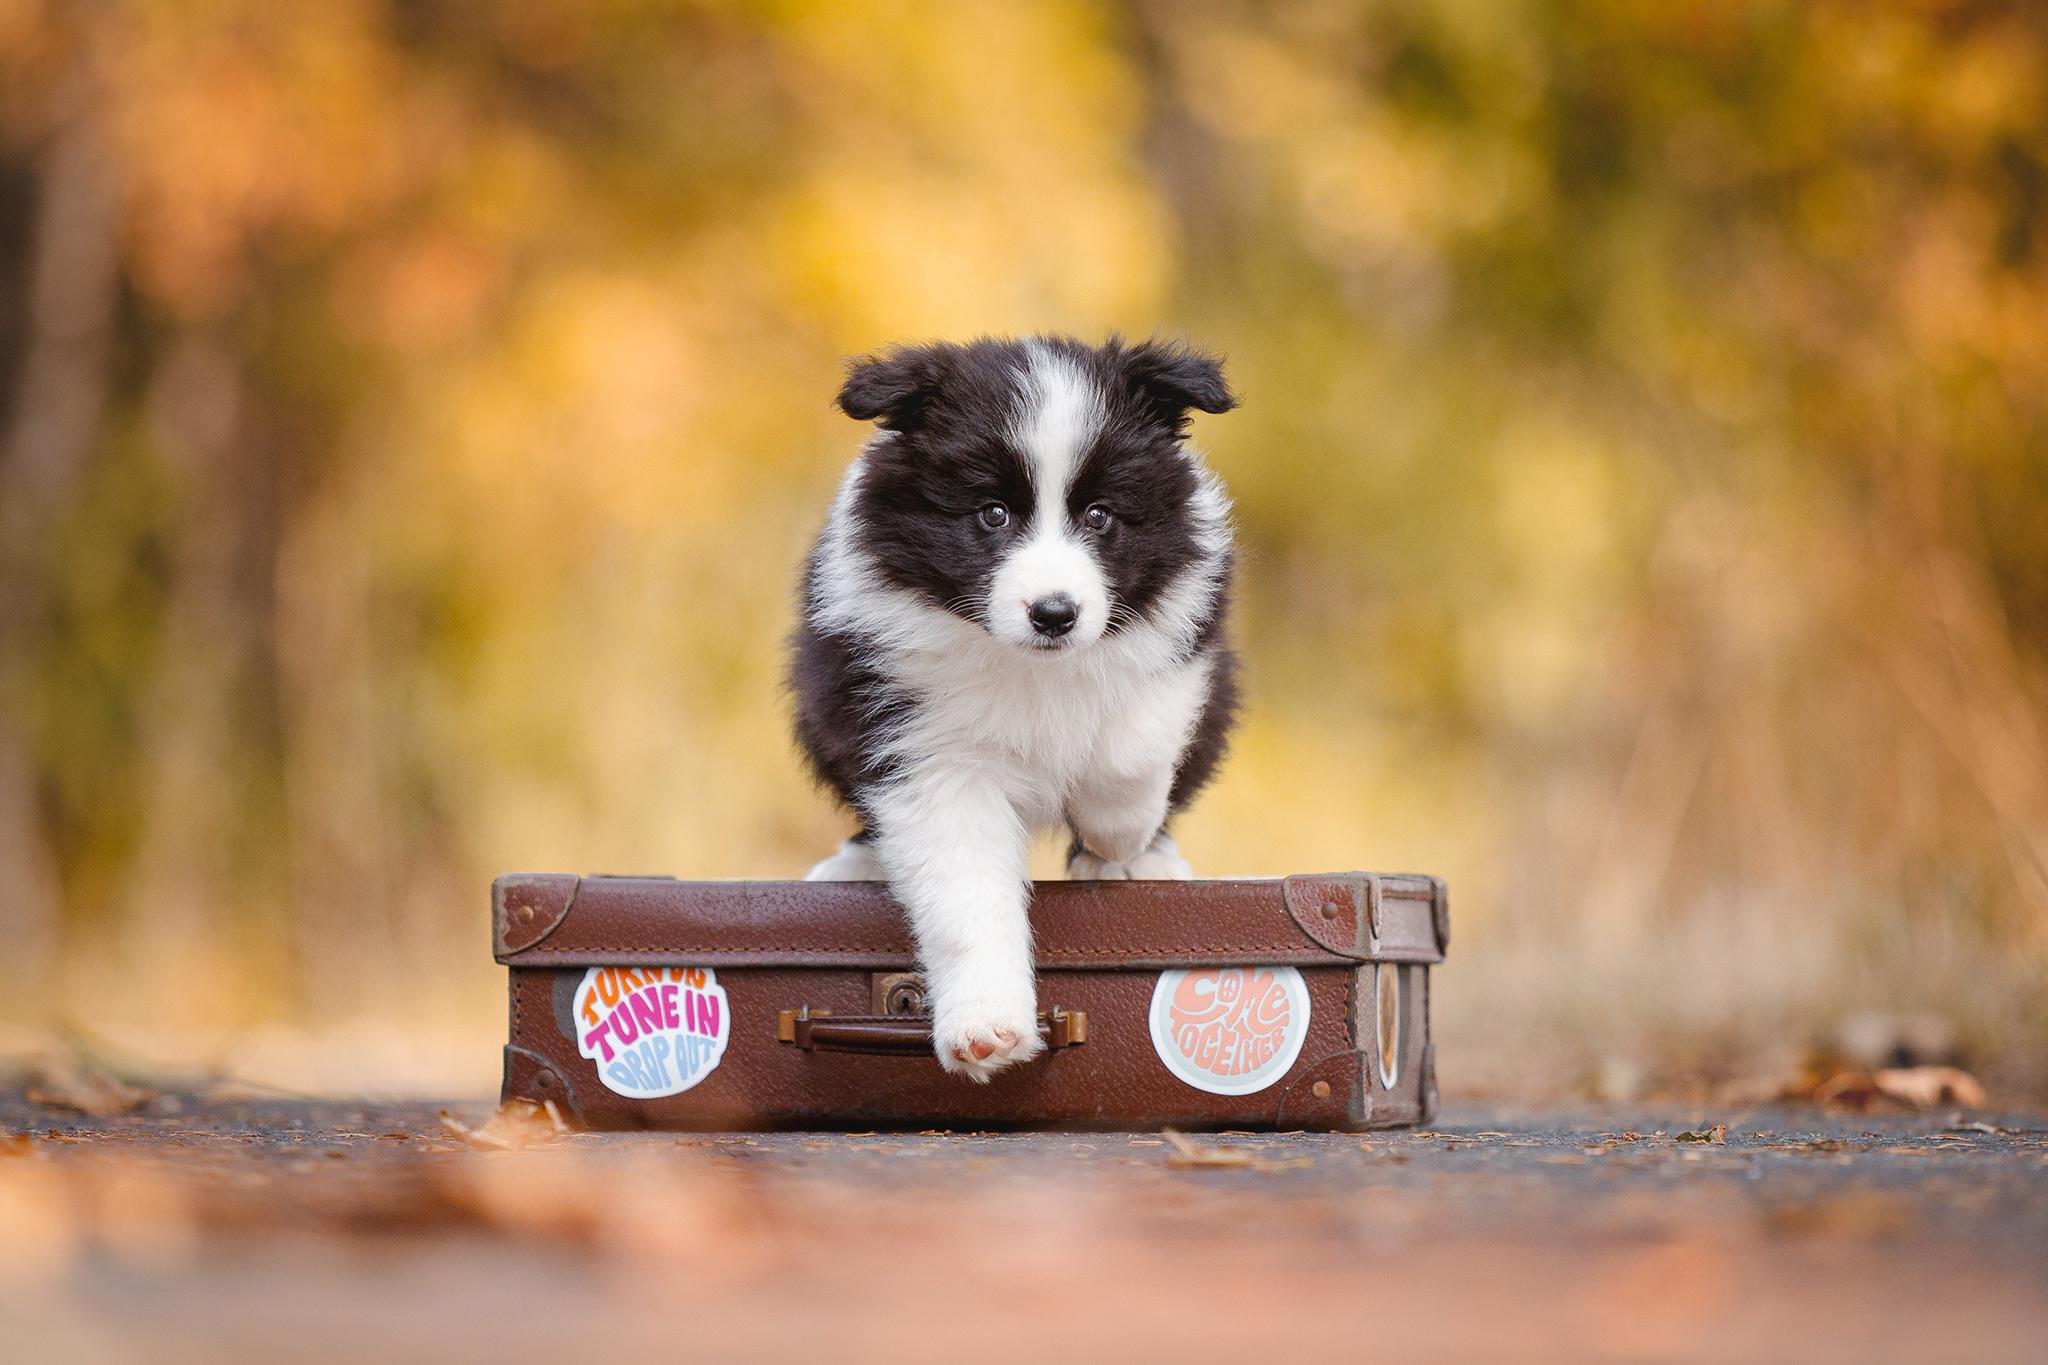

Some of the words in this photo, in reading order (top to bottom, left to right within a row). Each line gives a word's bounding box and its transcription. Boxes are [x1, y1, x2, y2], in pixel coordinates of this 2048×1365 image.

[584, 985, 680, 1063] TUNE
[685, 990, 720, 1038] IN
[1169, 1004, 1286, 1076] TOGETHER
[606, 1035, 672, 1091] DROP
[675, 1034, 716, 1081] OUT
